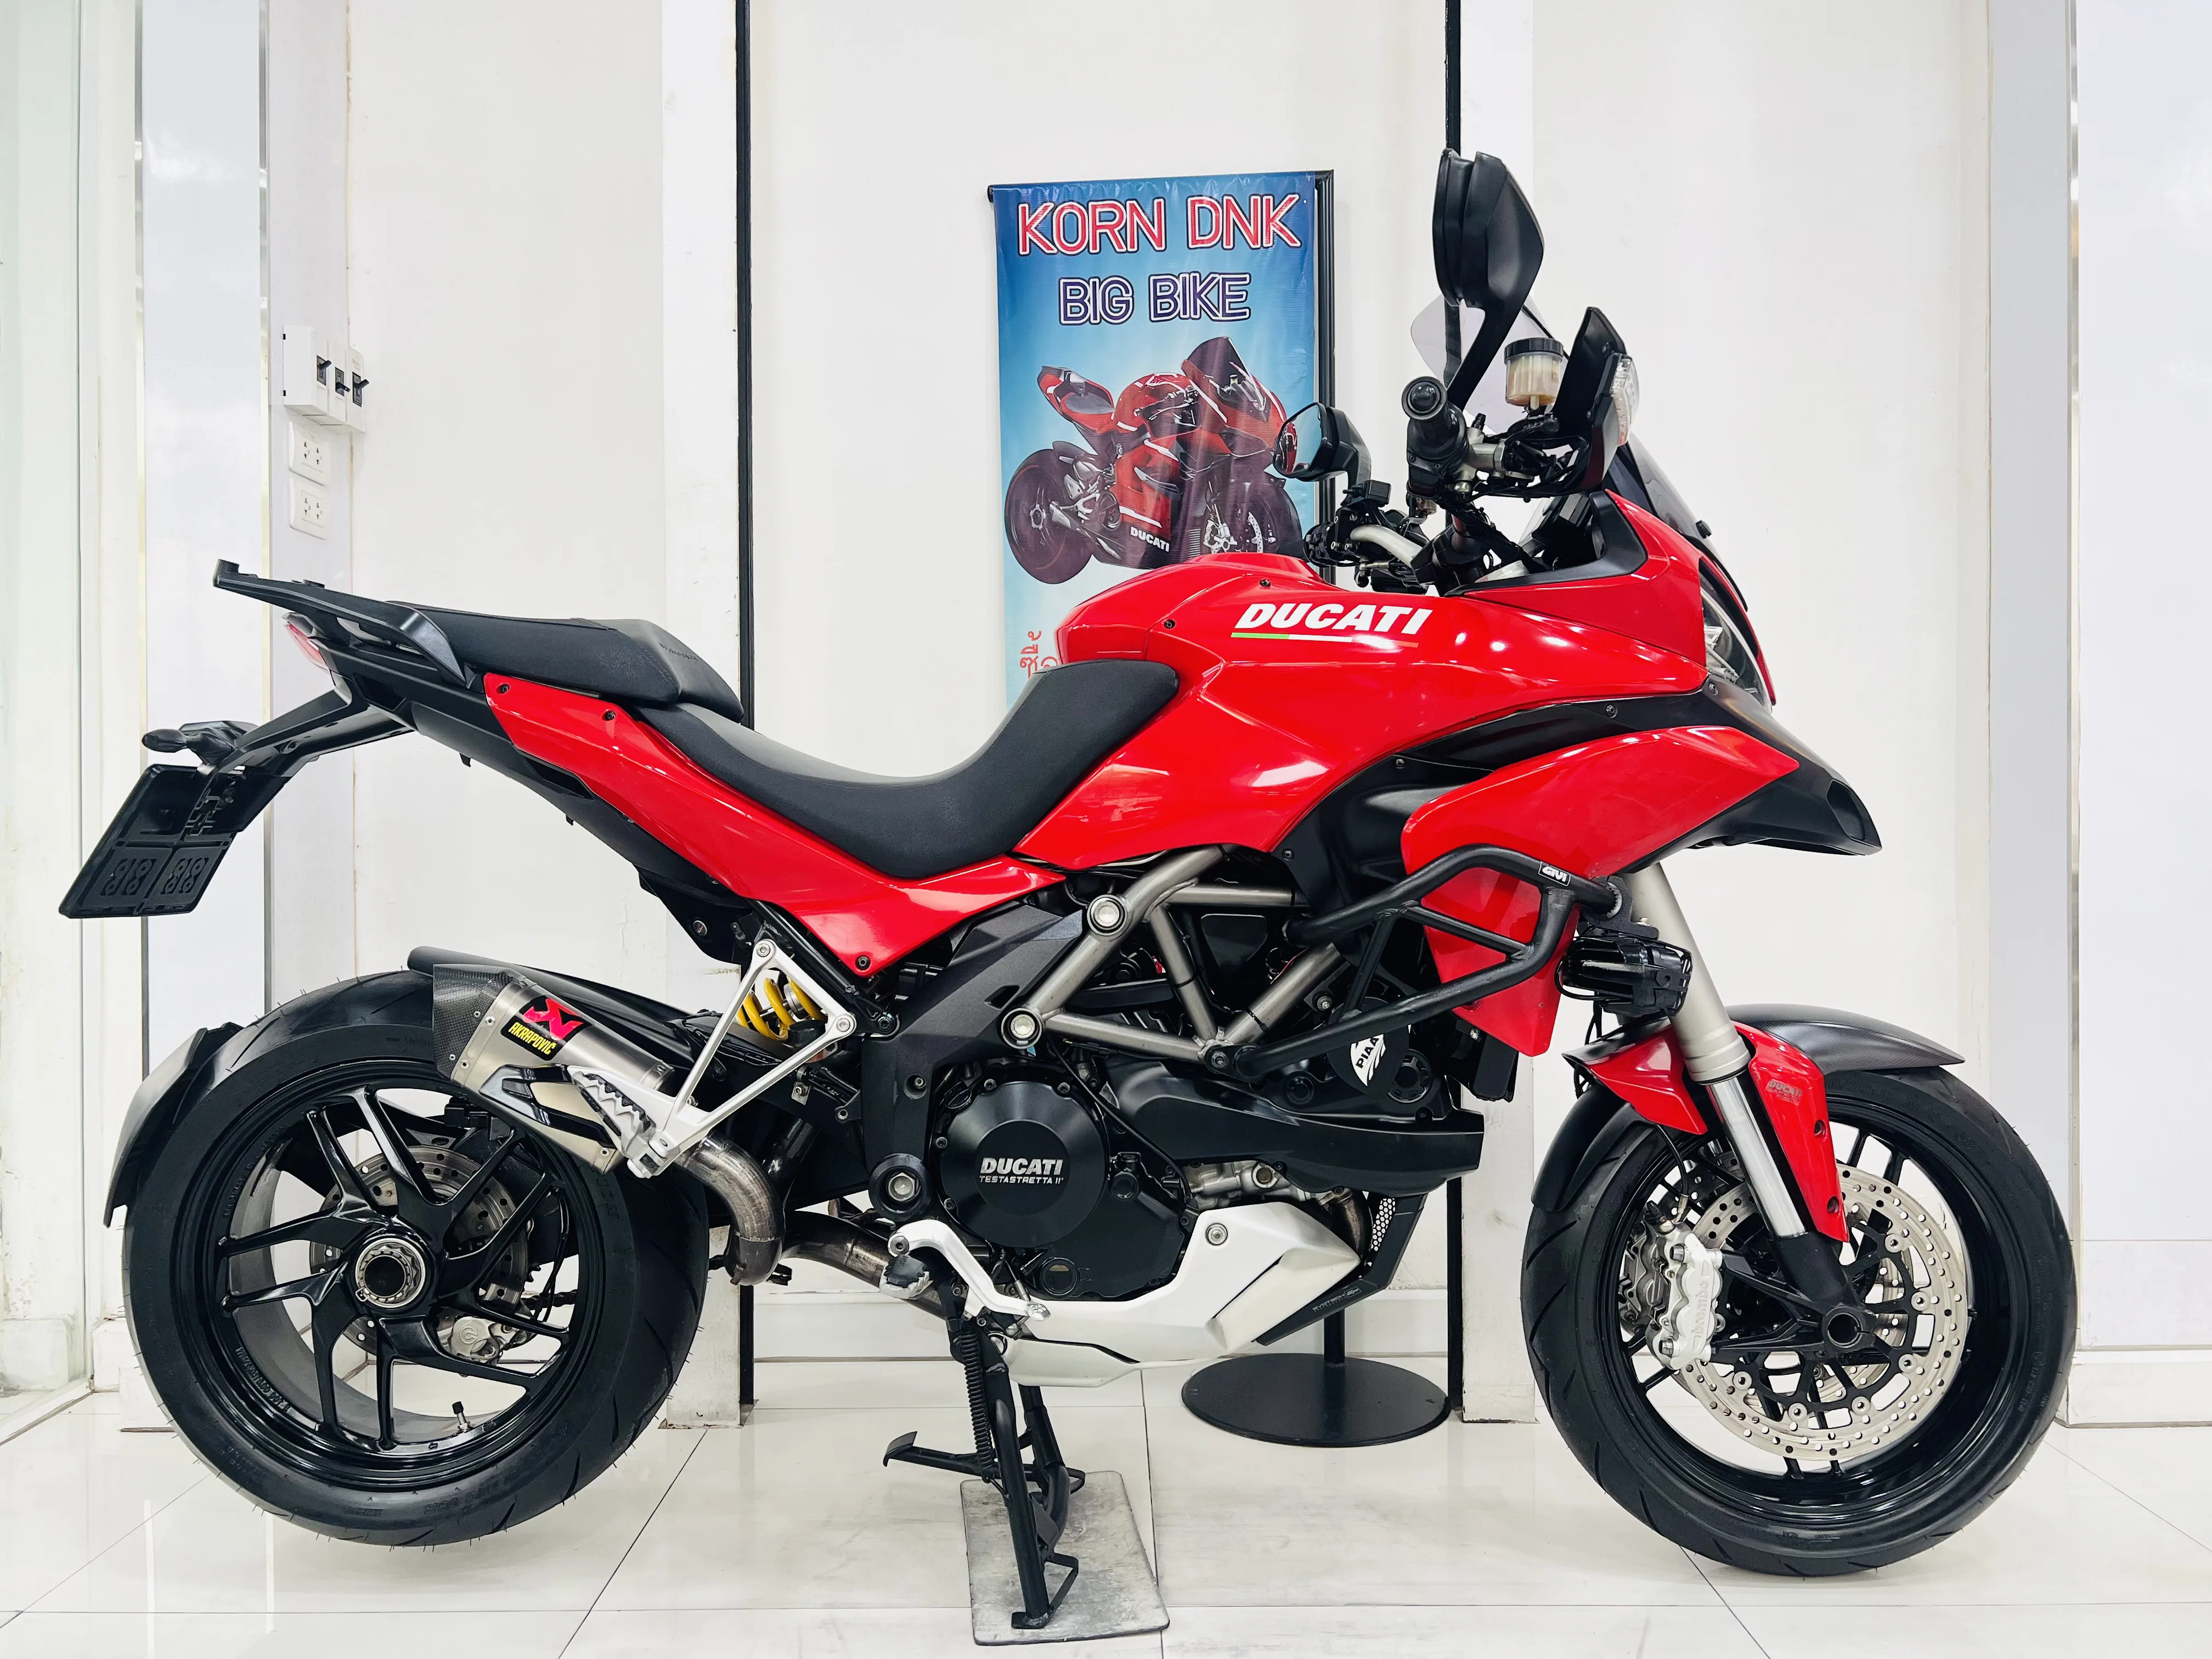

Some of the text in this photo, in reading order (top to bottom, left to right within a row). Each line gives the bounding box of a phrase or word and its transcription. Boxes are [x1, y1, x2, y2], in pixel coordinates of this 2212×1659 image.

[1017, 193, 1302, 256] KORN DNK
[1058, 272, 1251, 326] BIG BIKE
[1130, 526, 1170, 552] DUCATI
[1234, 603, 1433, 635] DUCATI
[1542, 866, 1567, 882] GIVI
[1355, 1037, 1379, 1069] PIAA
[979, 1175, 1053, 1184] TESTASTRETTA
[980, 1157, 1063, 1175] DUCATI
